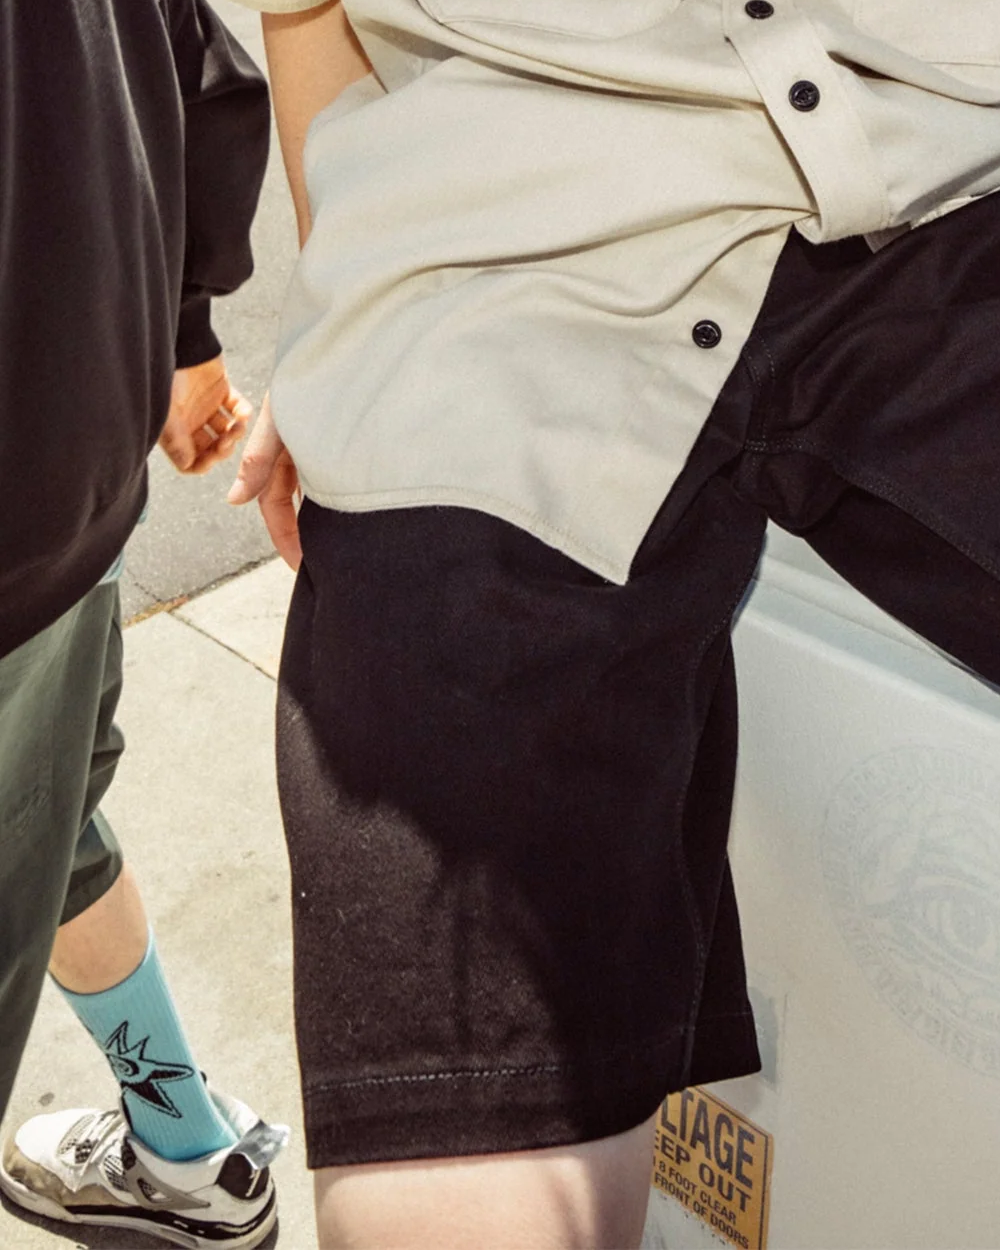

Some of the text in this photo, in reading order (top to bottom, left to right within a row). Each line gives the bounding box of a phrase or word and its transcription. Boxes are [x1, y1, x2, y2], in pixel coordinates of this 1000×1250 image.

[655, 1172, 749, 1250] FRONT OF DOORS
[669, 1166, 698, 1194] FOOT
[700, 1191, 736, 1226] CLEAR
[699, 1163, 752, 1212] OUT
